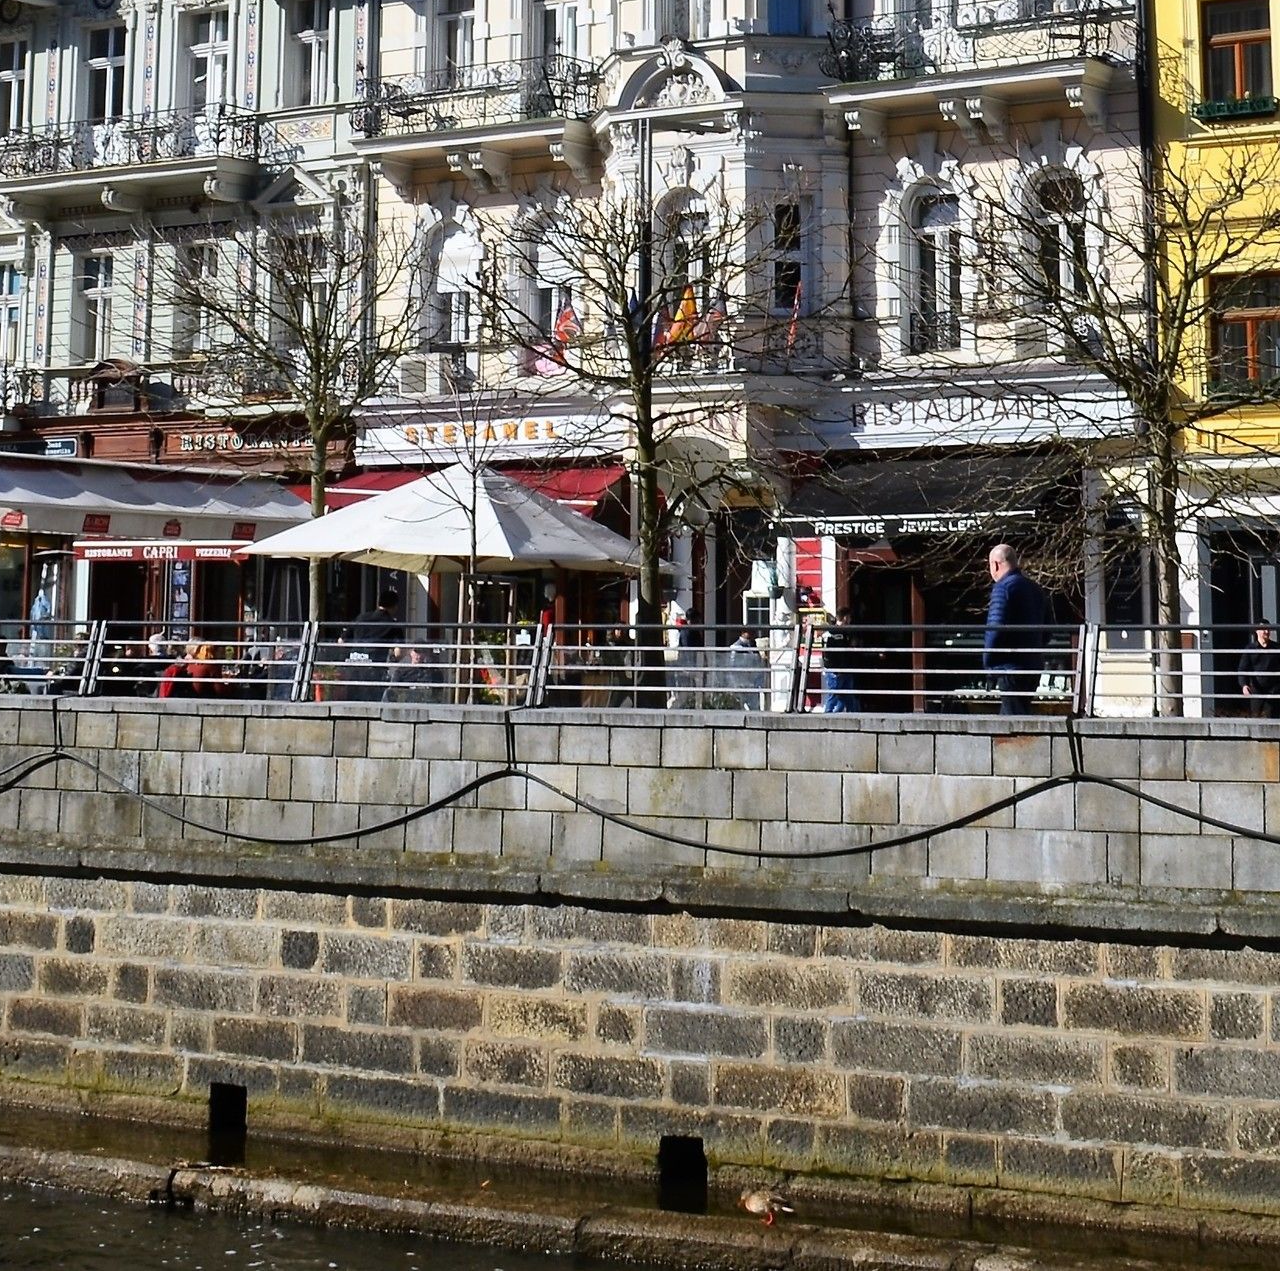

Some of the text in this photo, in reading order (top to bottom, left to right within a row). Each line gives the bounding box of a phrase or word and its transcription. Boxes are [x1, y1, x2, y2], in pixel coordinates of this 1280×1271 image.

[406, 420, 559, 444] STEFANEL
[180, 432, 315, 450] RISTORANTE
[815, 521, 885, 535] PRESTIGE
[84, 546, 232, 559] RISTORANTE CAPRI PIZZERIA
